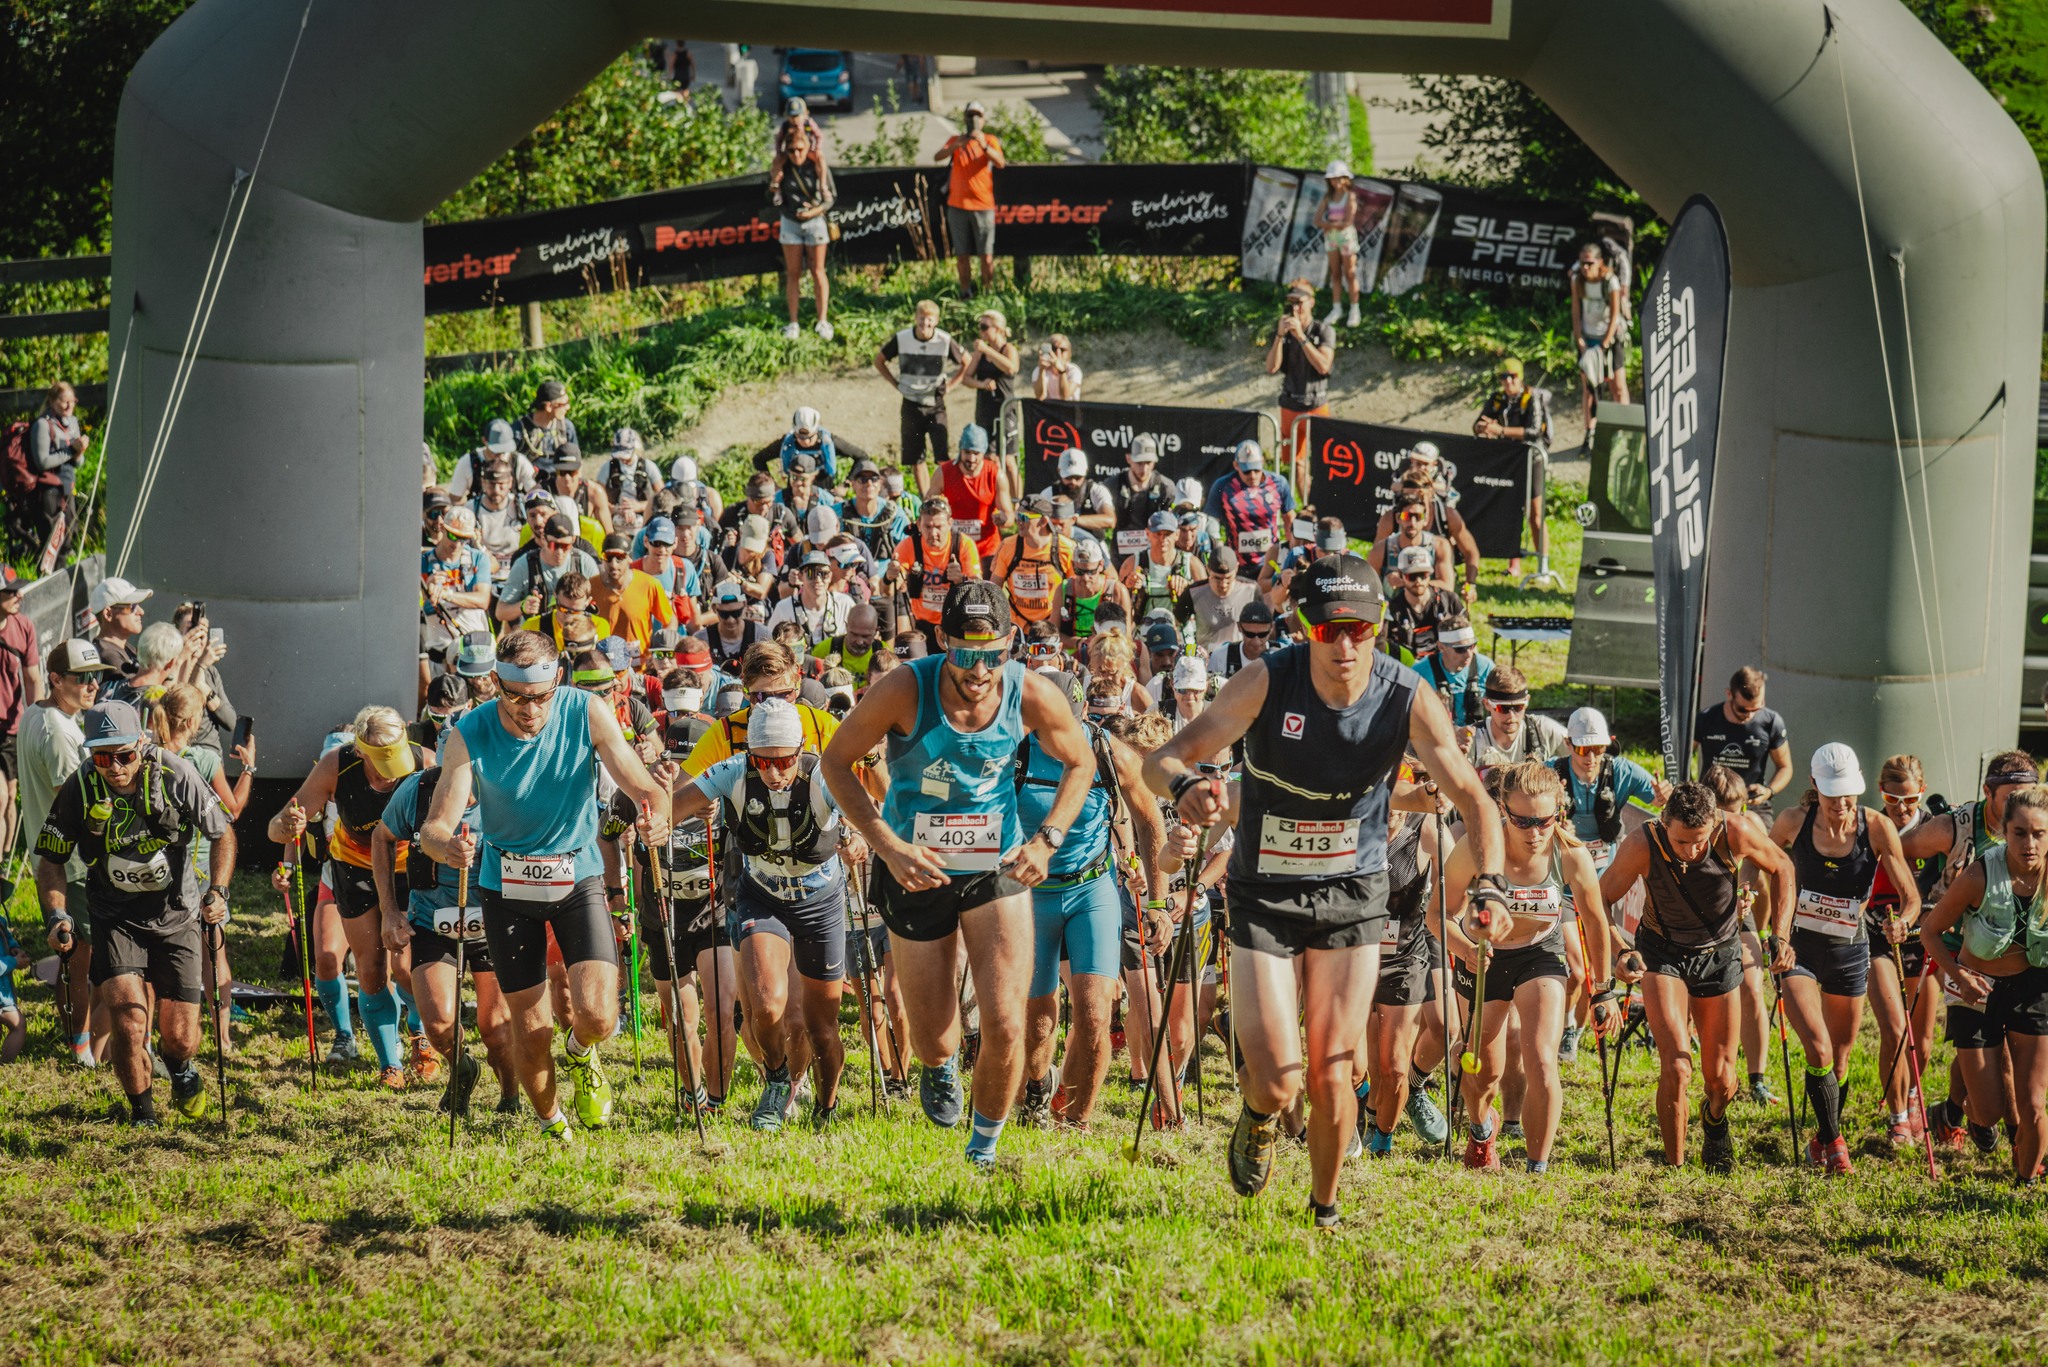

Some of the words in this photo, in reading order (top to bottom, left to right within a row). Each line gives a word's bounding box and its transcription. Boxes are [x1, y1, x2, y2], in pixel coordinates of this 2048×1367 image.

[829, 197, 901, 226] Evolving
[995, 199, 1104, 226] werbar
[1131, 190, 1215, 218] Evolving
[1146, 204, 1229, 231] mindsets
[1451, 214, 1576, 246] SILBER
[538, 227, 613, 262] Evolving
[1471, 241, 1565, 270] PFEIL
[1448, 265, 1515, 285] ENERGY
[1520, 274, 1562, 290] DRIN
[1315, 575, 1354, 587] Grosseck-
[947, 816, 986, 826] saalbach
[1298, 823, 1342, 833] saalbach
[939, 831, 976, 846] 403
[1289, 837, 1331, 851] 413
[113, 866, 166, 883] 9623
[522, 865, 553, 879] 402
[1510, 903, 1539, 912] 414
[1815, 907, 1841, 918] 408
